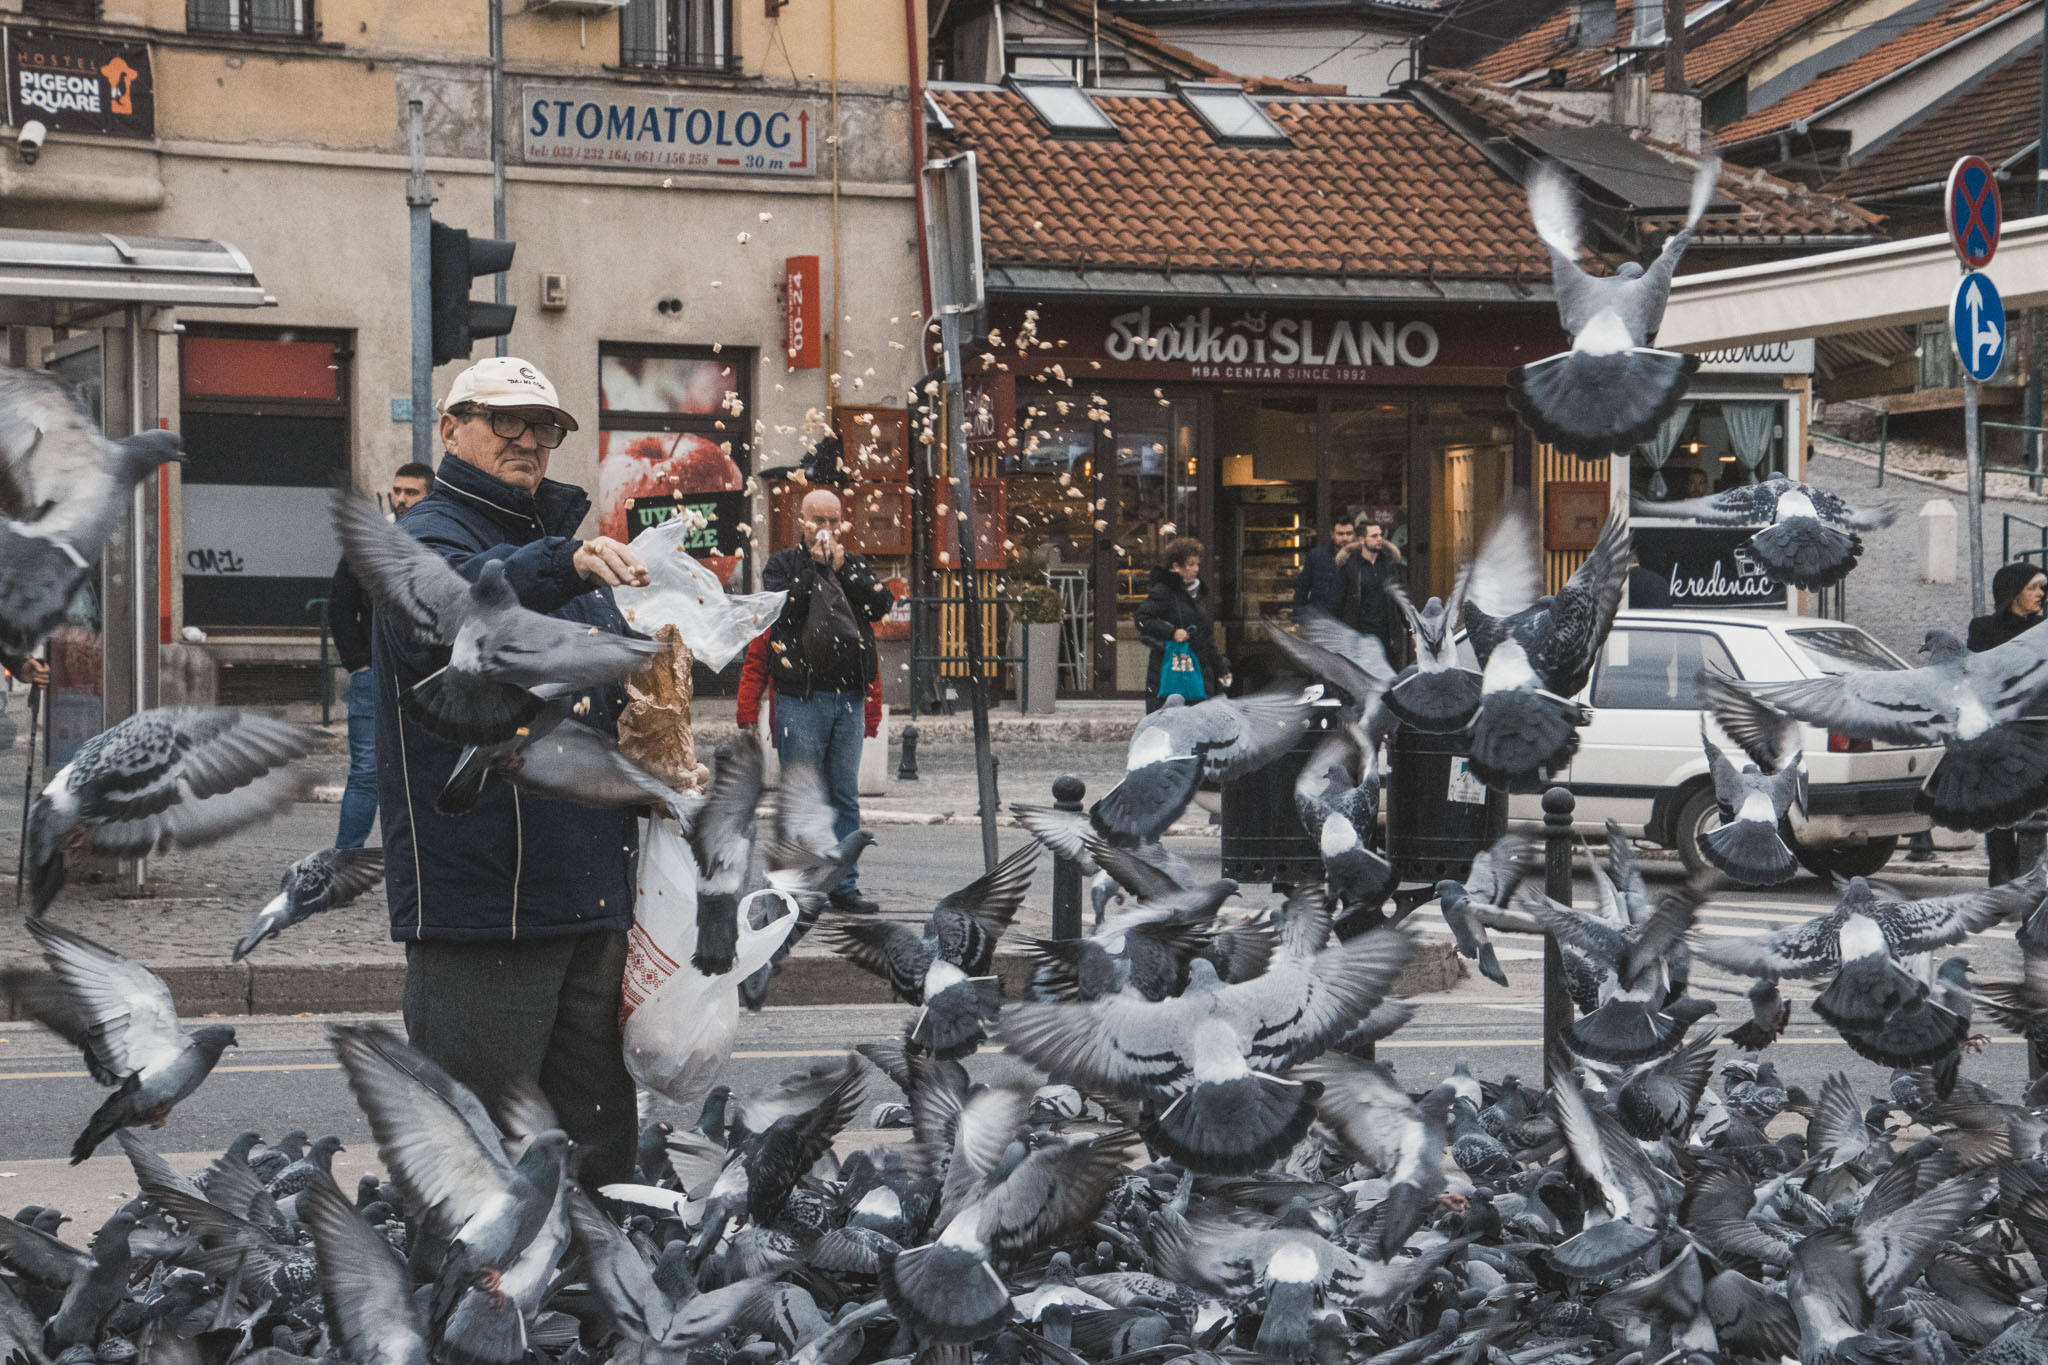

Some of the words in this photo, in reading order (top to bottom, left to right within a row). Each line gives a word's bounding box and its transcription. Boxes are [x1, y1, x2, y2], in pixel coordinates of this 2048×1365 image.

[18, 52, 97, 72] HOSTEL
[20, 71, 99, 95] PIGEON
[20, 88, 102, 113] SQUARE
[530, 99, 791, 148] STOMATOLOG
[745, 155, 765, 169] 30
[769, 159, 784, 170] m
[793, 272, 803, 351] 00-24
[1105, 305, 1250, 363] Slatko
[1270, 319, 1439, 367] SLANO
[1191, 366, 1220, 378] MBA
[1226, 367, 1281, 379] CENTAR
[1288, 369, 1329, 381] SINCE
[1336, 370, 1368, 381] 1992
[1670, 560, 1775, 598] kredenac
